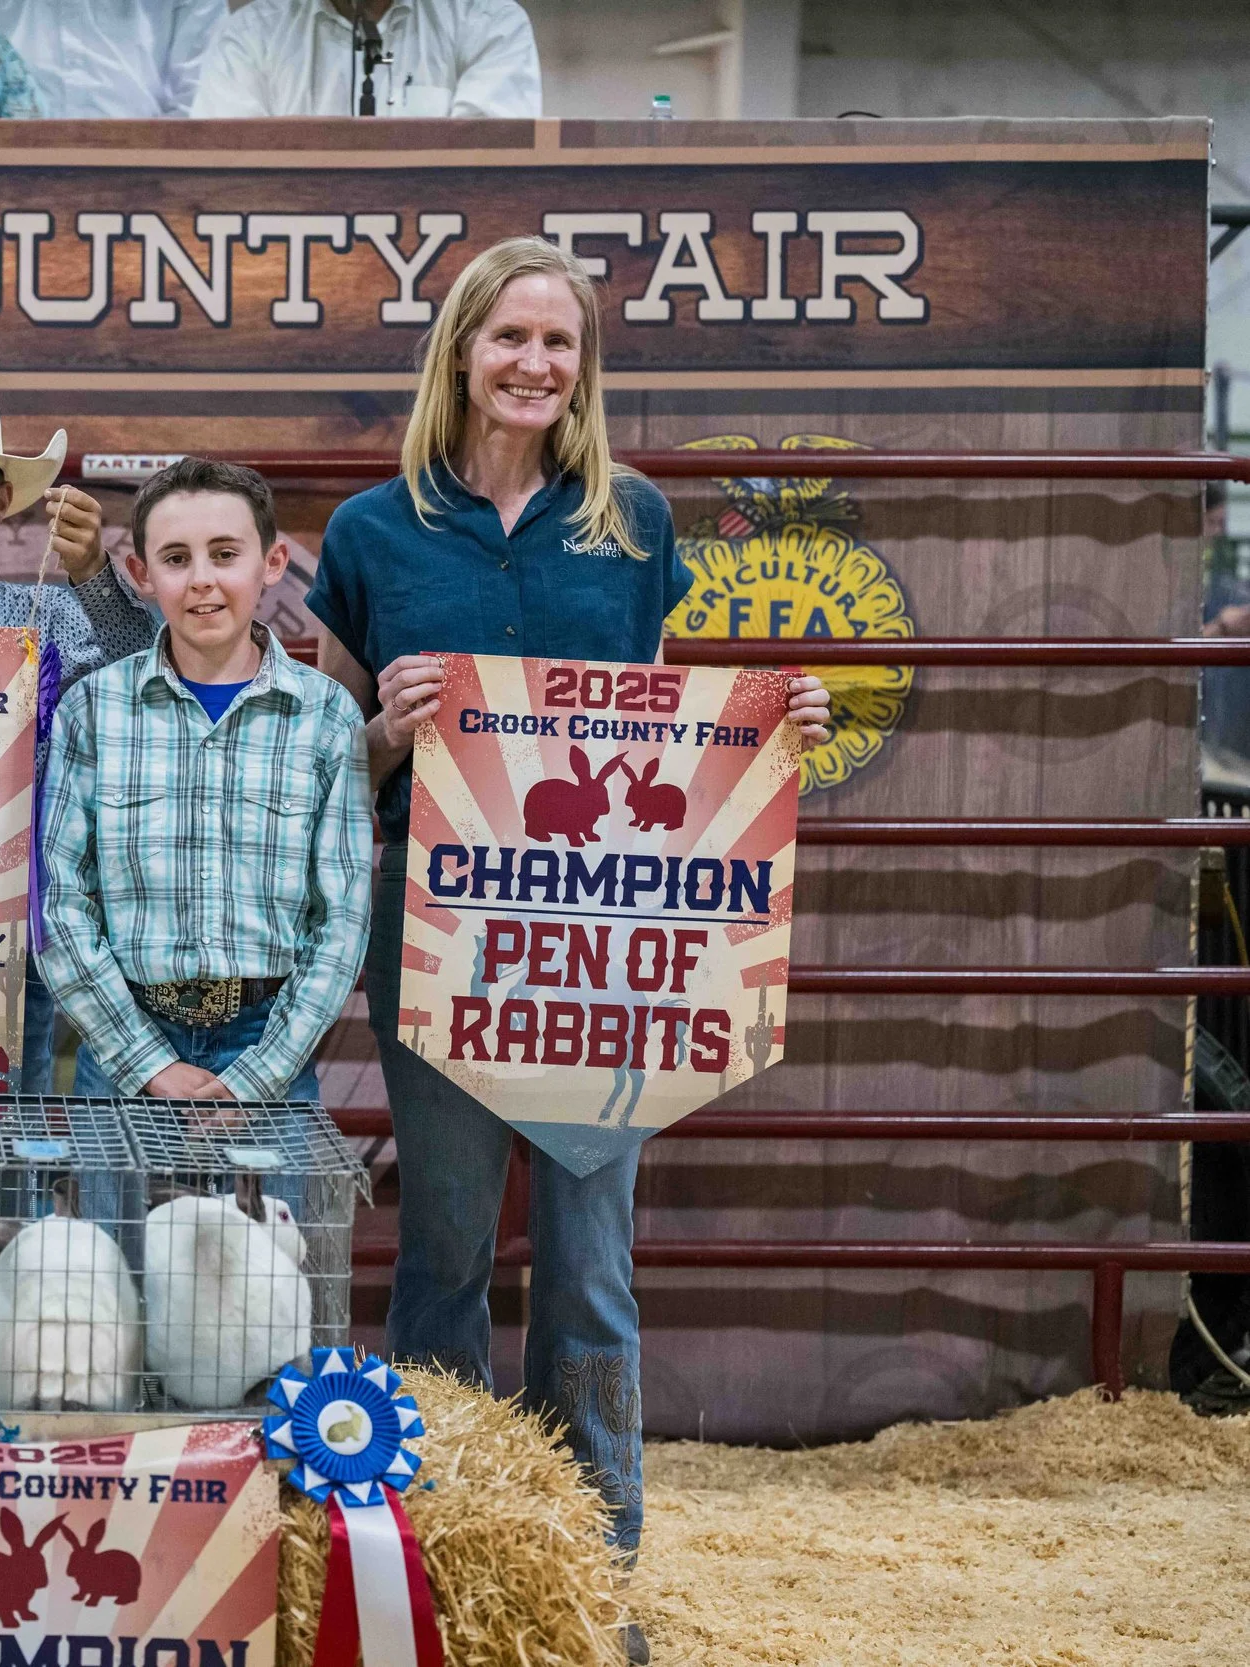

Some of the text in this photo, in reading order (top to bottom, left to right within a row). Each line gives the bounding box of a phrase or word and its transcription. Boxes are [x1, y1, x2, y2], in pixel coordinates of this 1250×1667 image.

[542, 210, 930, 326] FAIR
[86, 459, 167, 469] TARTER
[561, 539, 623, 552] NeSun
[587, 550, 623, 558] ENERGY
[671, 559, 870, 640] GRICULTURA
[728, 597, 834, 639] FFA
[544, 667, 682, 713] 2025
[458, 708, 761, 748] CROOK COUNTY FAIR
[426, 843, 774, 914] CHAMPION
[481, 918, 708, 994] PEN OF
[214, 995, 226, 1003] 25
[448, 995, 732, 1074] RABBITS
[148, 1474, 228, 1504] FAIR
